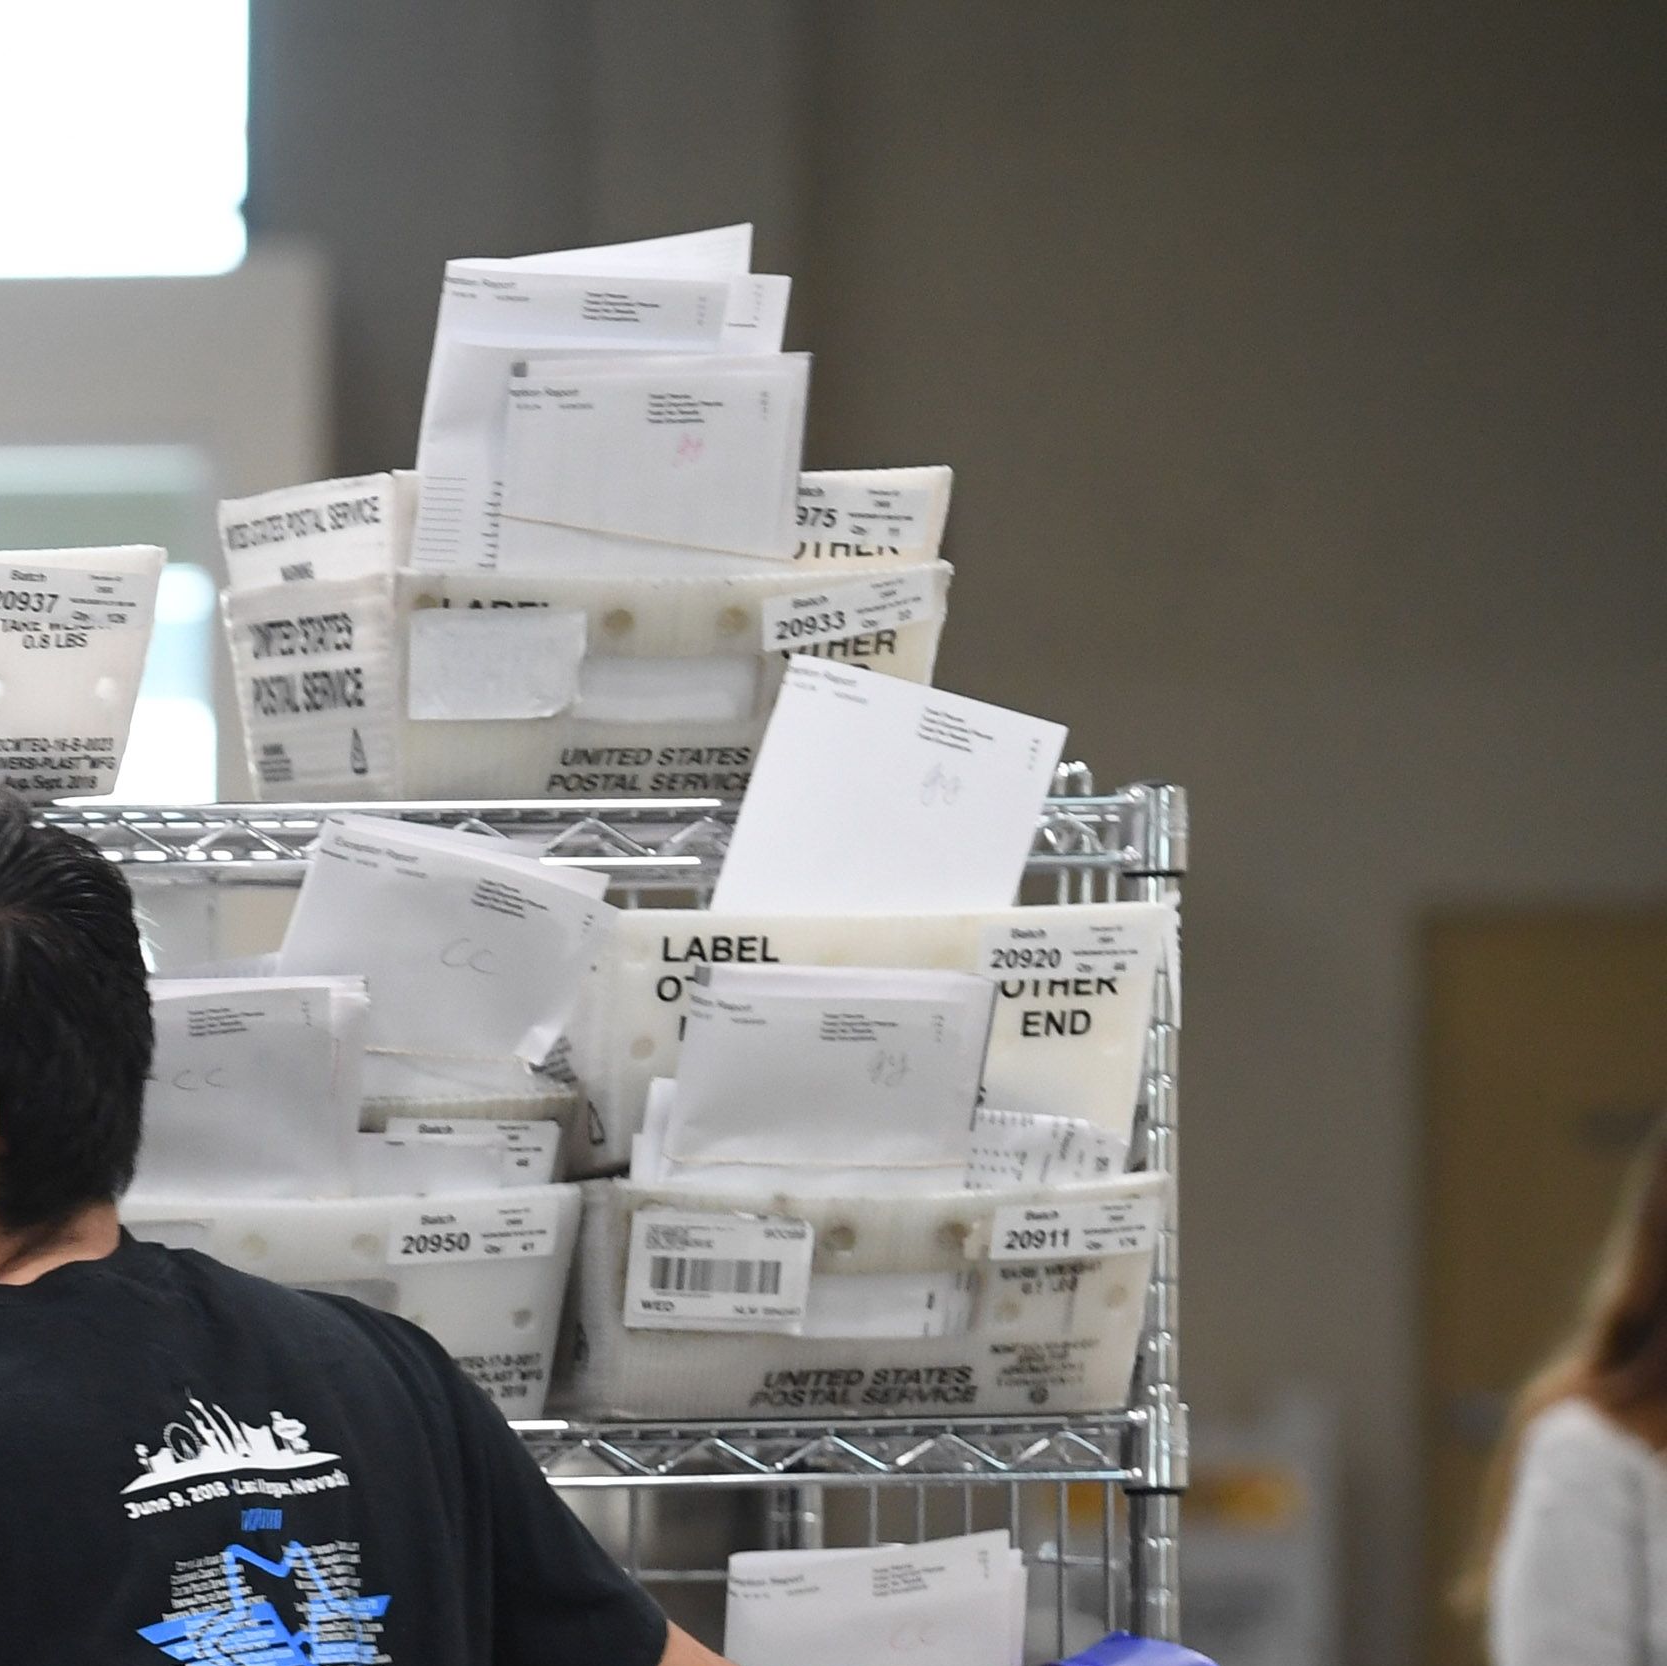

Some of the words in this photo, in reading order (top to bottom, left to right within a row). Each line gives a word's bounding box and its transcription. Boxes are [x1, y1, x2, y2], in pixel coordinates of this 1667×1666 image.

[795, 506, 837, 529] 975
[11, 569, 47, 582] Batch
[774, 610, 847, 641] 20933
[54, 632, 88, 649] LBS
[560, 747, 653, 767] UNITED
[656, 746, 751, 767] STATES
[546, 773, 642, 792] POSTAL
[661, 936, 780, 964] LABEL
[989, 947, 1063, 970] 20920
[1020, 1008, 1093, 1038] END
[420, 1214, 458, 1226] Batch
[400, 1231, 472, 1255] 20950
[1003, 1227, 1071, 1250] 20911
[763, 1368, 865, 1388] UNITED
[871, 1365, 973, 1386] STATES
[749, 1386, 855, 1408] POSTAL
[862, 1385, 979, 1407] SERVICE
[124, 1497, 171, 1519] June
